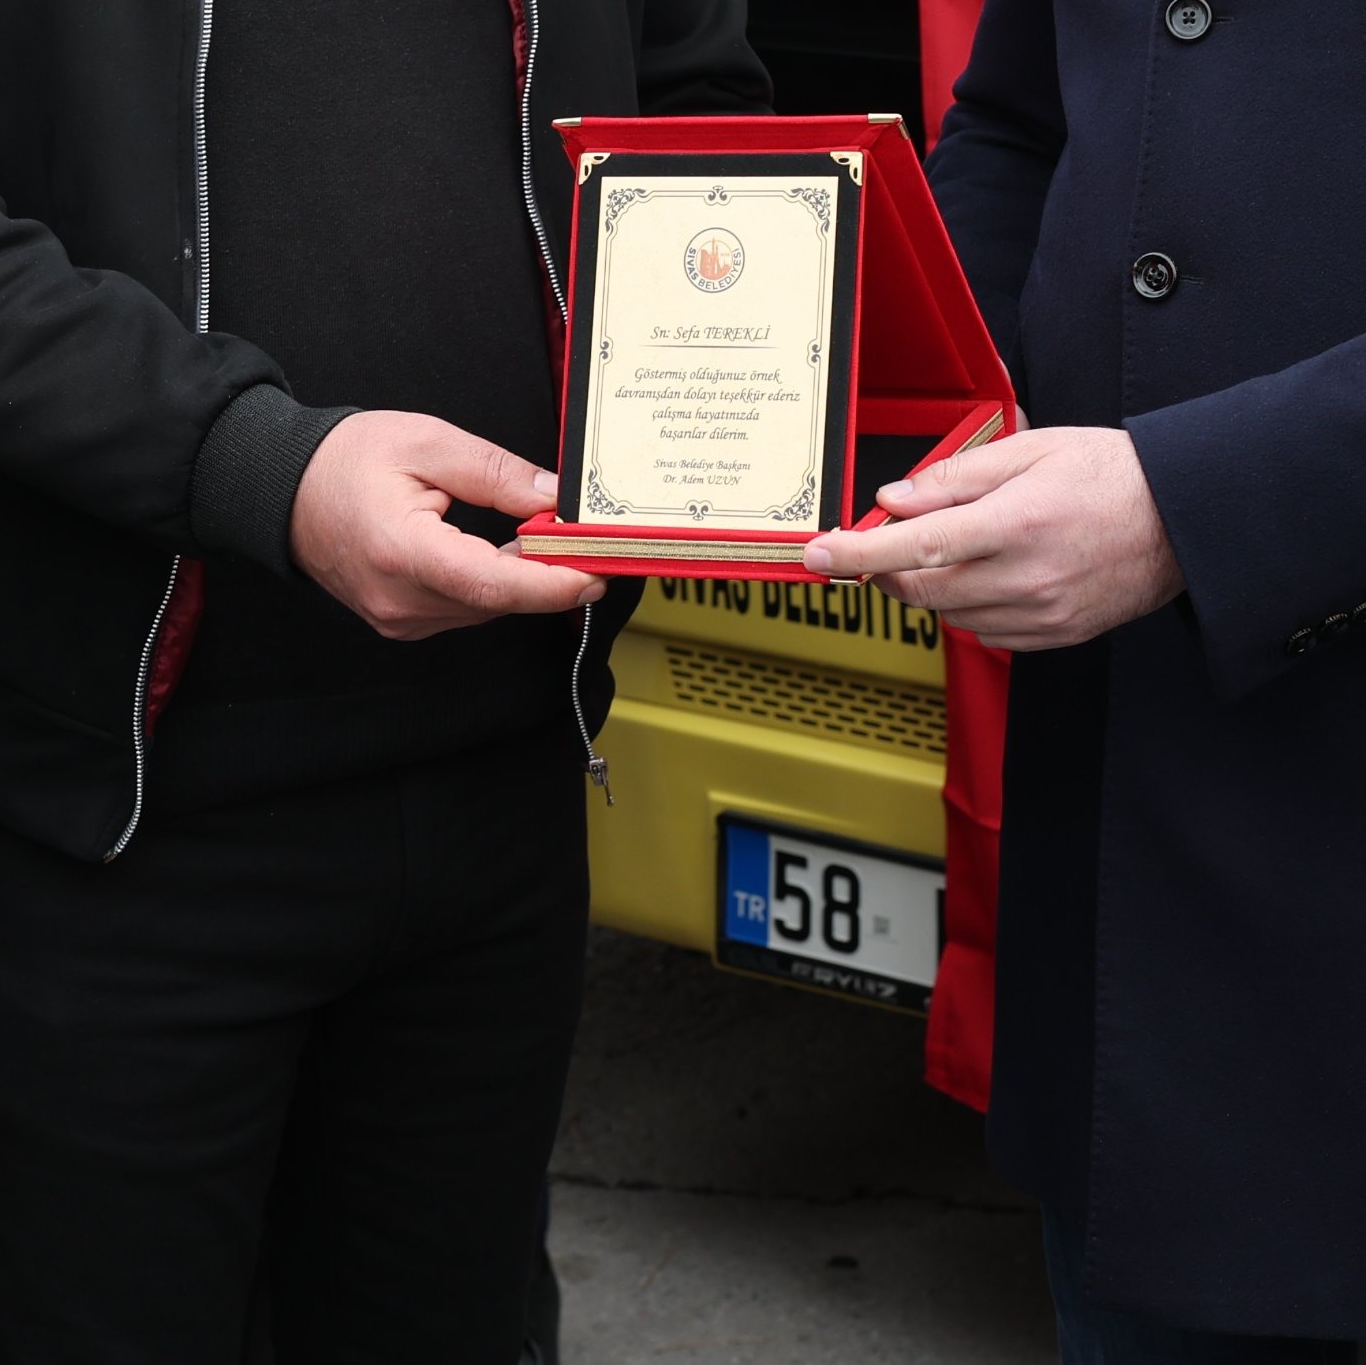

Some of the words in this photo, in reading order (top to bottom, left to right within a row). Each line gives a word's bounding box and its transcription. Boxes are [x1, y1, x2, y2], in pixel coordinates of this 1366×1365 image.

[673, 325, 700, 343] Sefa
[703, 324, 772, 342] TEREKLİ
[634, 367, 688, 383] Göstermiş
[689, 367, 747, 384] olduğunuz
[749, 368, 783, 385] örnek
[614, 386, 681, 402] davranışdan
[683, 386, 717, 403] dolayı
[719, 387, 766, 404] teşekkür
[767, 388, 801, 402] ederiz
[651, 406, 692, 422] çalışma
[694, 406, 760, 424] hayatınızda
[659, 425, 707, 442] başarılar
[708, 426, 749, 441] dilerim.
[653, 458, 677, 469] Sivas
[678, 458, 714, 473] Belediye
[715, 459, 751, 473] Başkanı
[662, 474, 677, 484] Dr.
[677, 474, 704, 486] Adem
[706, 474, 743, 487] UZUN
[734, 890, 767, 923] TR
[773, 849, 861, 955] 58
